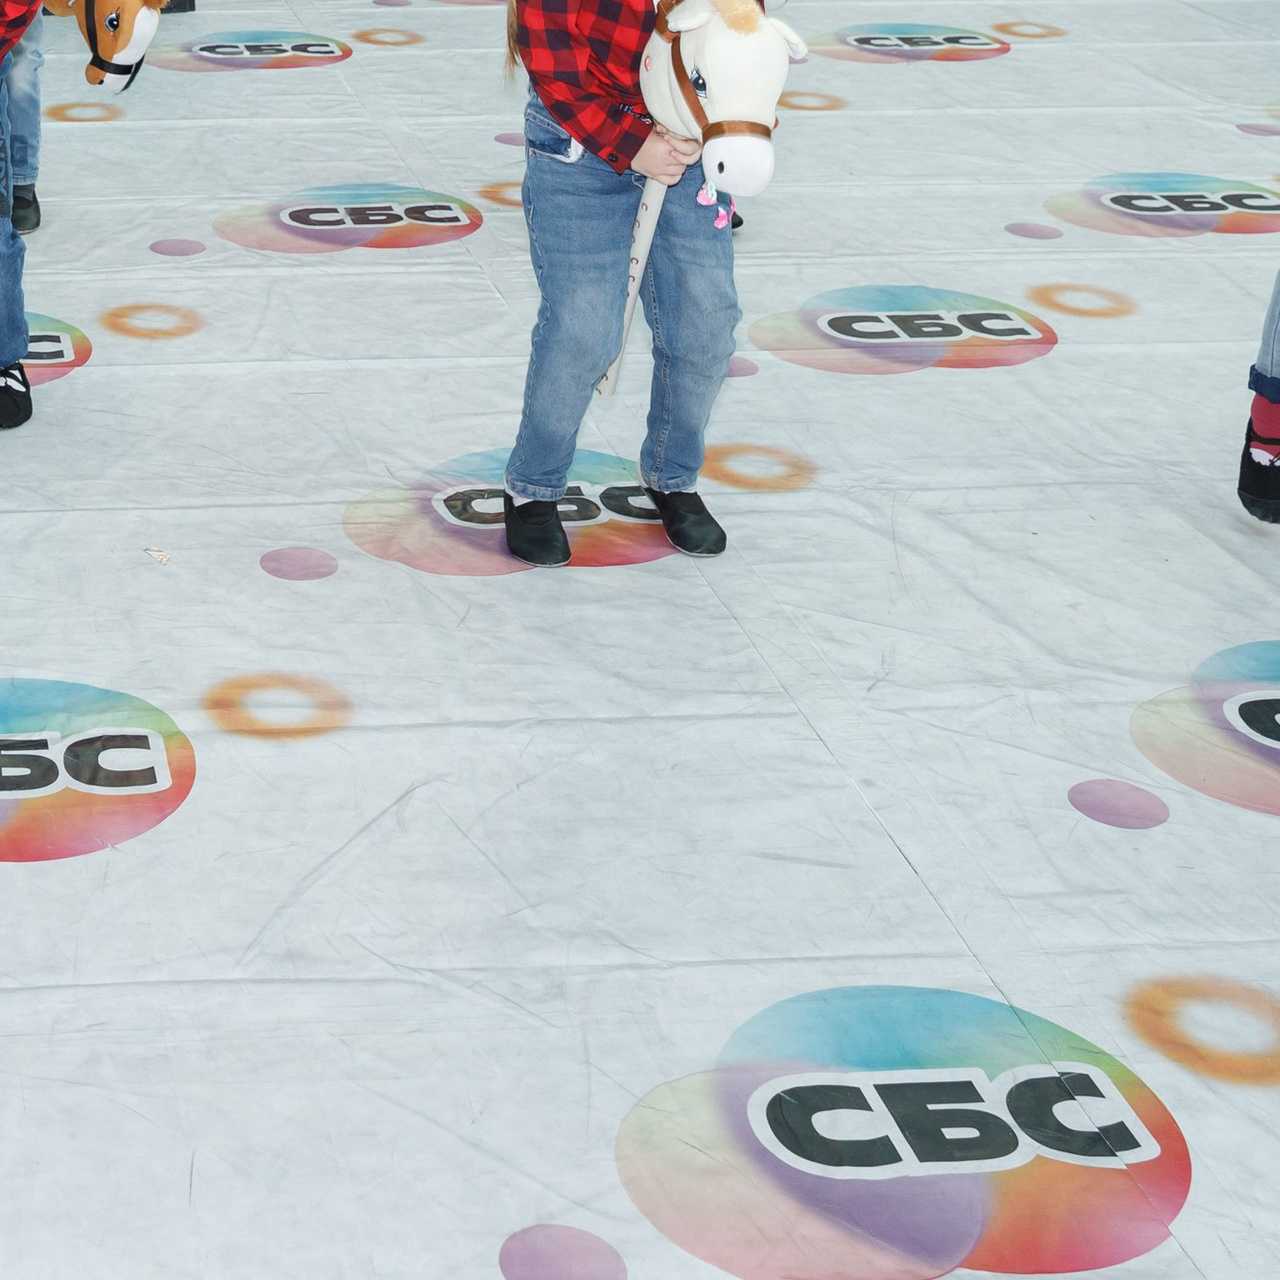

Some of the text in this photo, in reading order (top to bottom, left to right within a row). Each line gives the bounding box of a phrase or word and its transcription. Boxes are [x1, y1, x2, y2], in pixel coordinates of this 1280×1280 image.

[198, 42, 336, 57] СБС
[852, 35, 996, 49] СБС
[1109, 194, 1280, 212] СБС
[288, 204, 462, 226] СБС
[826, 312, 1029, 341] СБС
[765, 1072, 1142, 1168] СБС
